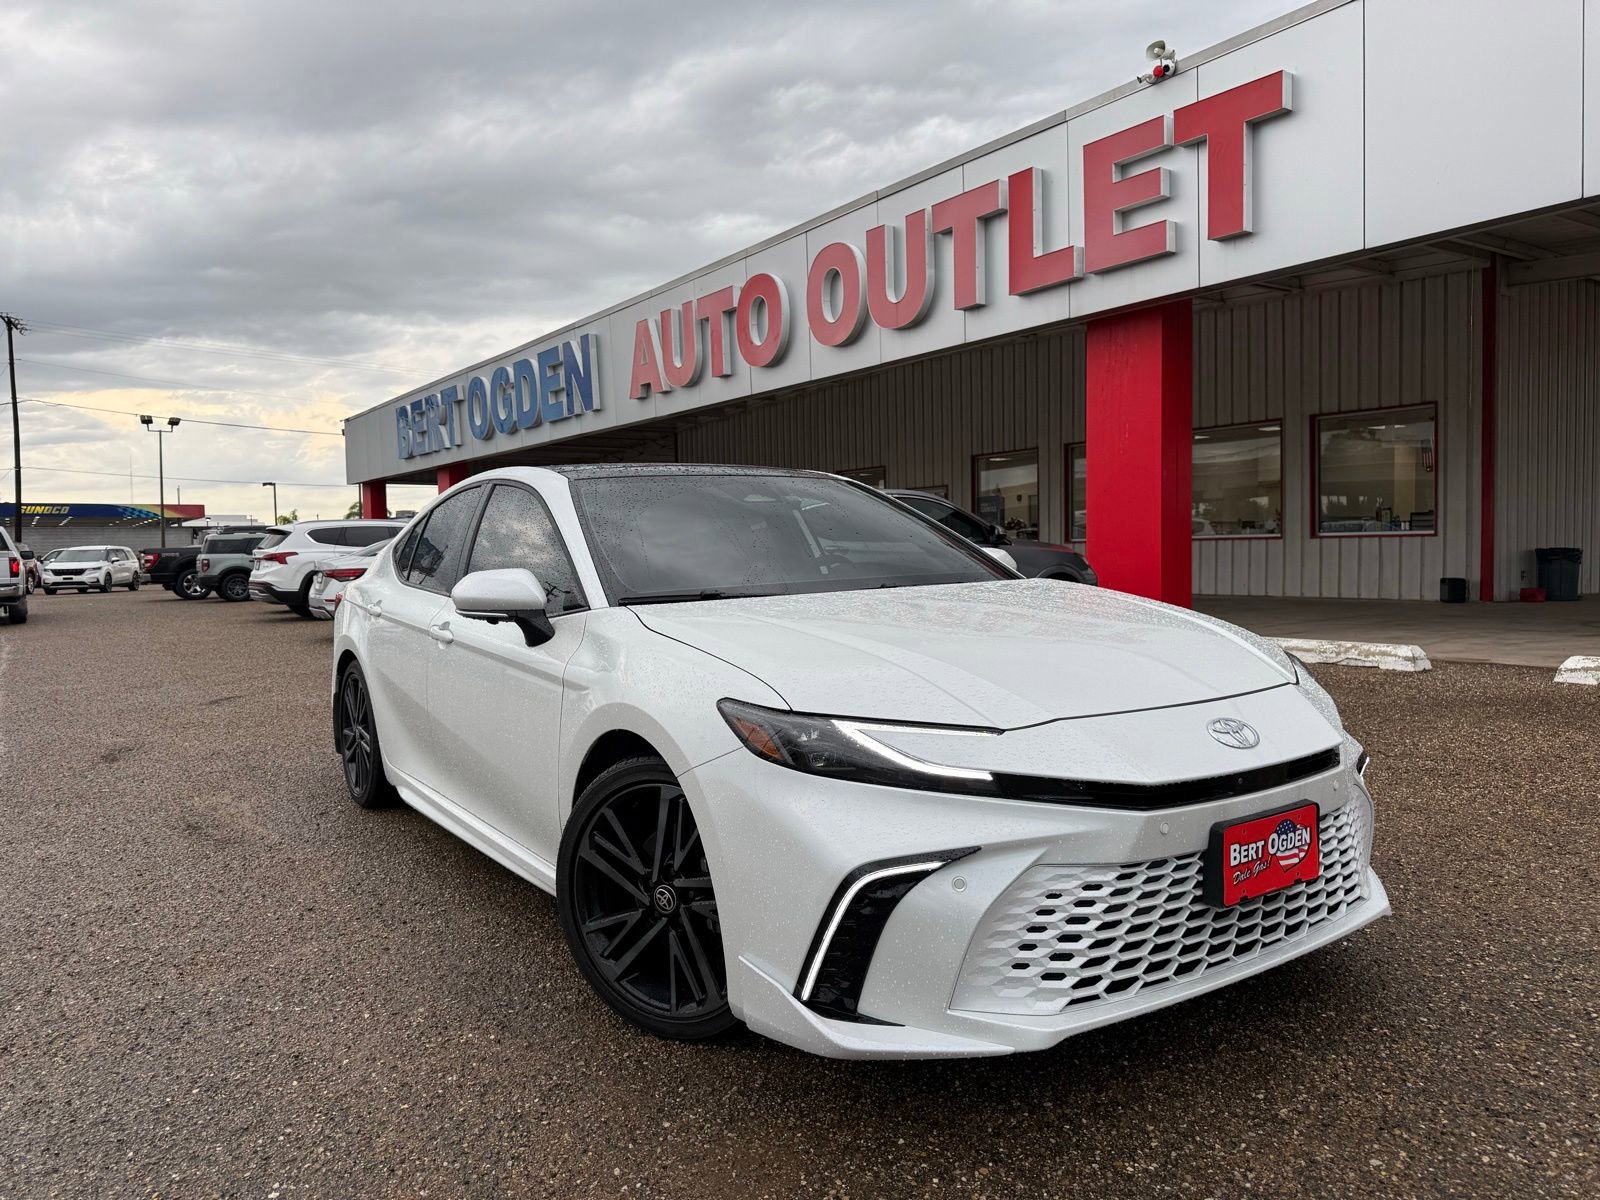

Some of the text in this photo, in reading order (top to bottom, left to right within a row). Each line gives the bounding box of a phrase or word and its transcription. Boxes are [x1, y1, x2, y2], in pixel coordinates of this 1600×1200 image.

[395, 69, 1293, 459] BERT OGDEN AUTO OUTLET
